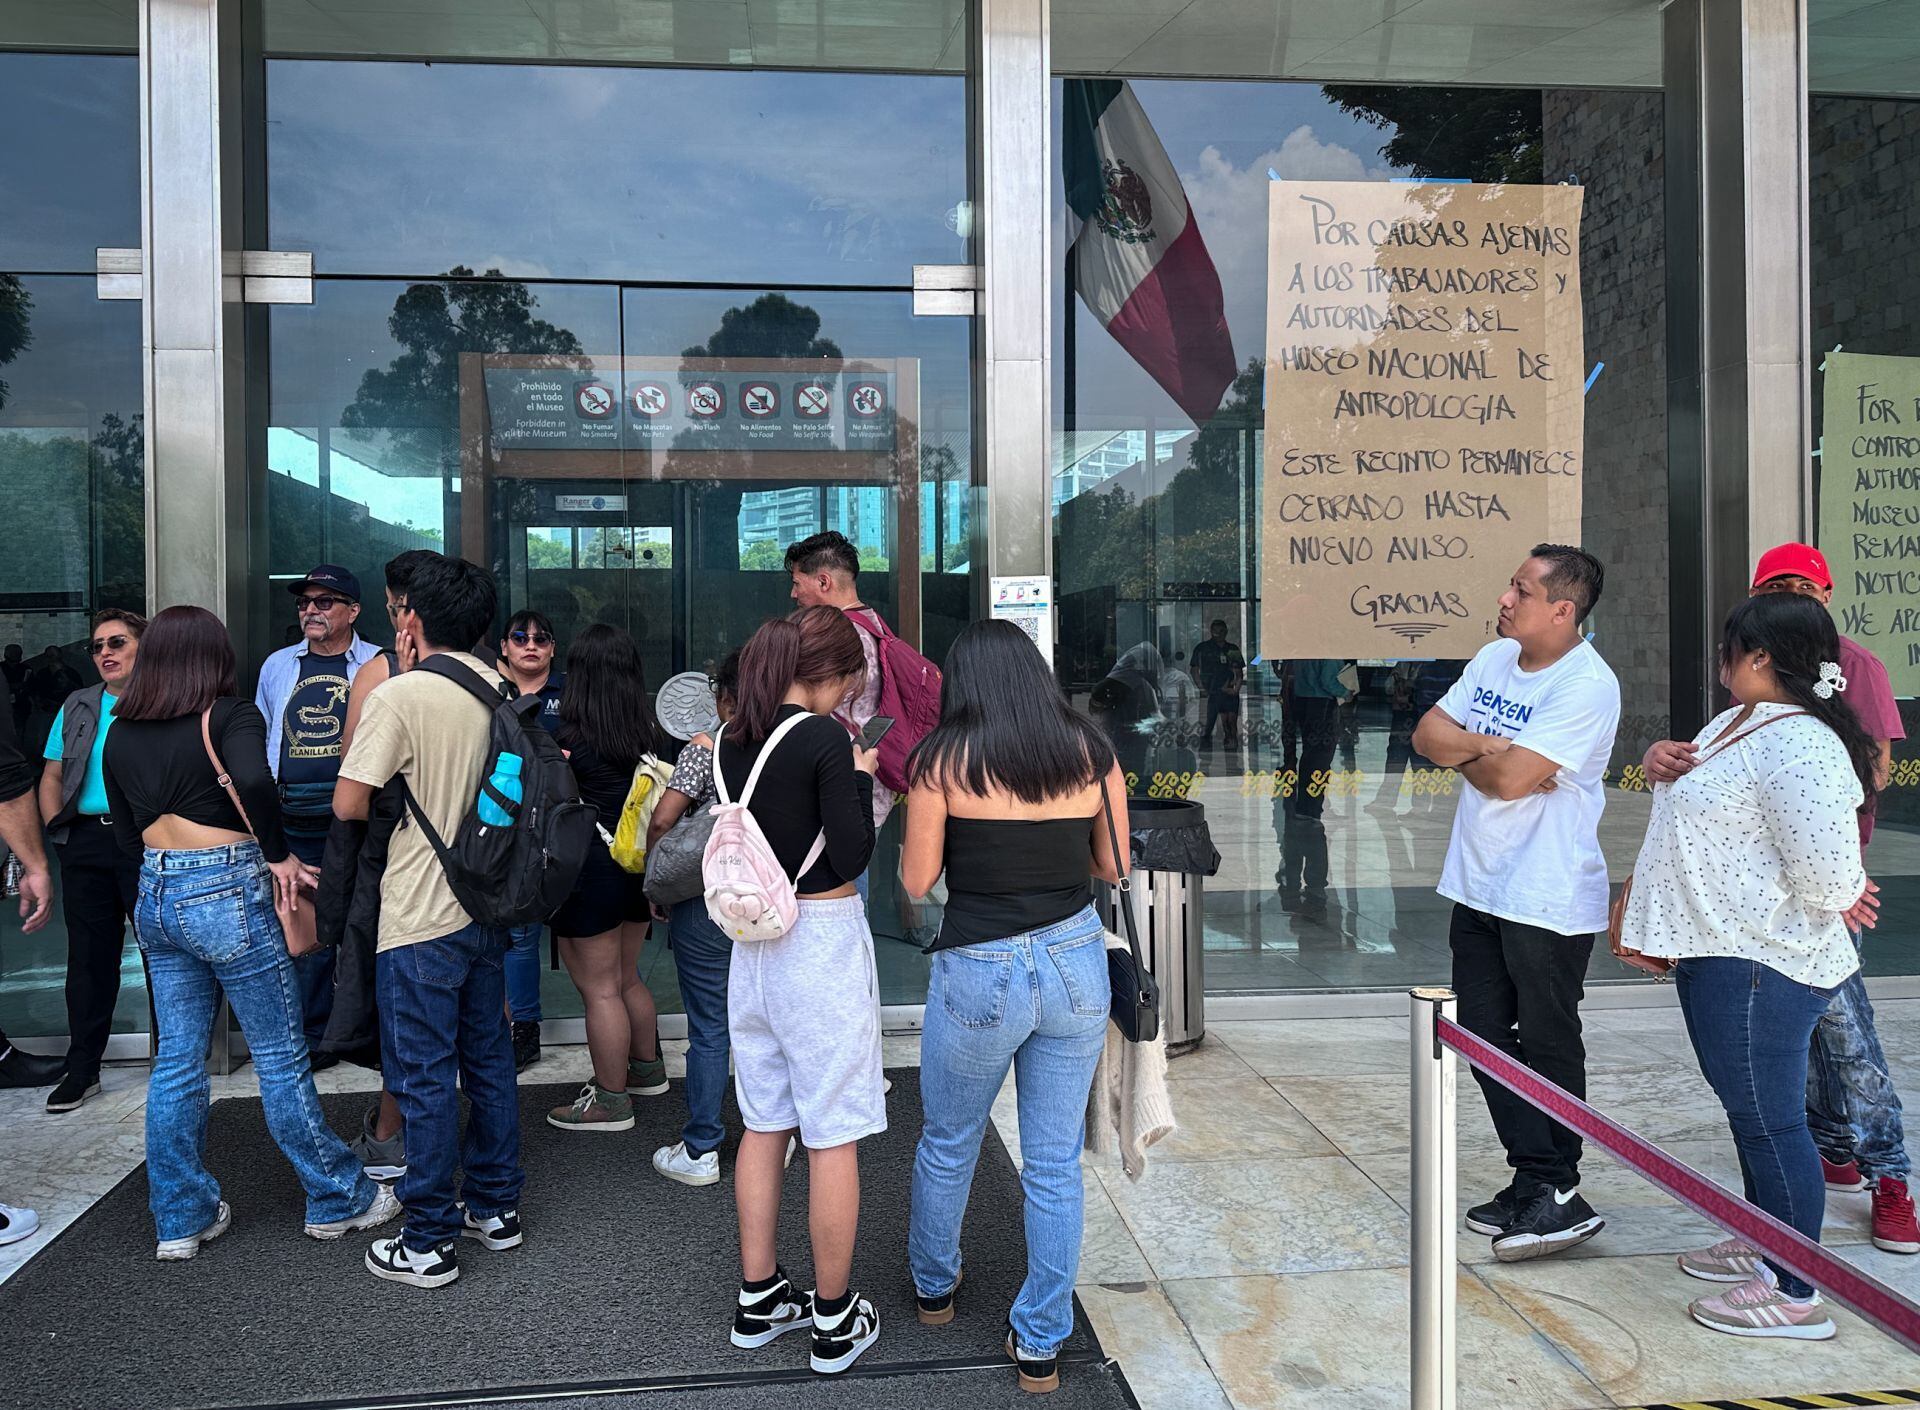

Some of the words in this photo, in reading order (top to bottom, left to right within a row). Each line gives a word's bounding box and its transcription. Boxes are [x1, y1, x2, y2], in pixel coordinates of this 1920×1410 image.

[1299, 194, 1360, 246] POR
[1367, 219, 1469, 249] CAUSAS
[1481, 222, 1571, 257] AJENAS
[1288, 262, 1306, 295] A
[1313, 261, 1354, 292] LOS
[1360, 266, 1539, 295] TRABAJADORES
[1286, 303, 1453, 333] AUTORIDADES
[1463, 306, 1519, 333] DEL
[1281, 345, 1359, 376] MUSEO
[1367, 348, 1498, 381] NACIONAL
[1518, 348, 1554, 381] DE
[521, 382, 562, 391] Prohibido
[543, 392, 563, 401] todo
[526, 402, 535, 411] el
[536, 402, 564, 411] Museo
[1333, 389, 1517, 424] ANTROPOLOGIA
[1857, 383, 1901, 424] FOR
[516, 419, 556, 428] Forbidden
[558, 419, 566, 428] in
[583, 423, 592, 431] No
[593, 423, 614, 431] Fumar
[633, 423, 642, 431] No
[643, 423, 673, 431] Mascotas
[694, 423, 704, 431] No
[704, 423, 720, 431] Flash
[740, 423, 749, 431] No
[749, 423, 782, 431] Alimentos
[792, 423, 802, 431] No
[803, 423, 817, 431] Palo
[852, 423, 862, 431] No
[517, 429, 531, 438] the
[532, 429, 567, 438] Museum
[591, 431, 618, 440] Smoking
[1851, 435, 1920, 458] CONTRO
[1281, 448, 1347, 477] ESTE
[1352, 449, 1451, 475] RECINTO
[1459, 448, 1577, 476] PERMANECE
[1279, 493, 1404, 523] CERRADO
[1425, 490, 1511, 521] HASTA
[1289, 536, 1373, 566] NUEVO
[1387, 534, 1475, 564] AVISO.
[1855, 569, 1920, 596] NOTIC
[1350, 584, 1470, 622] GRACIAS
[1841, 601, 1881, 636] WE
[290, 747, 329, 756] PLANILLA
[504, 1210, 517, 1220] NIKE
[442, 1242, 454, 1253] NIKE
